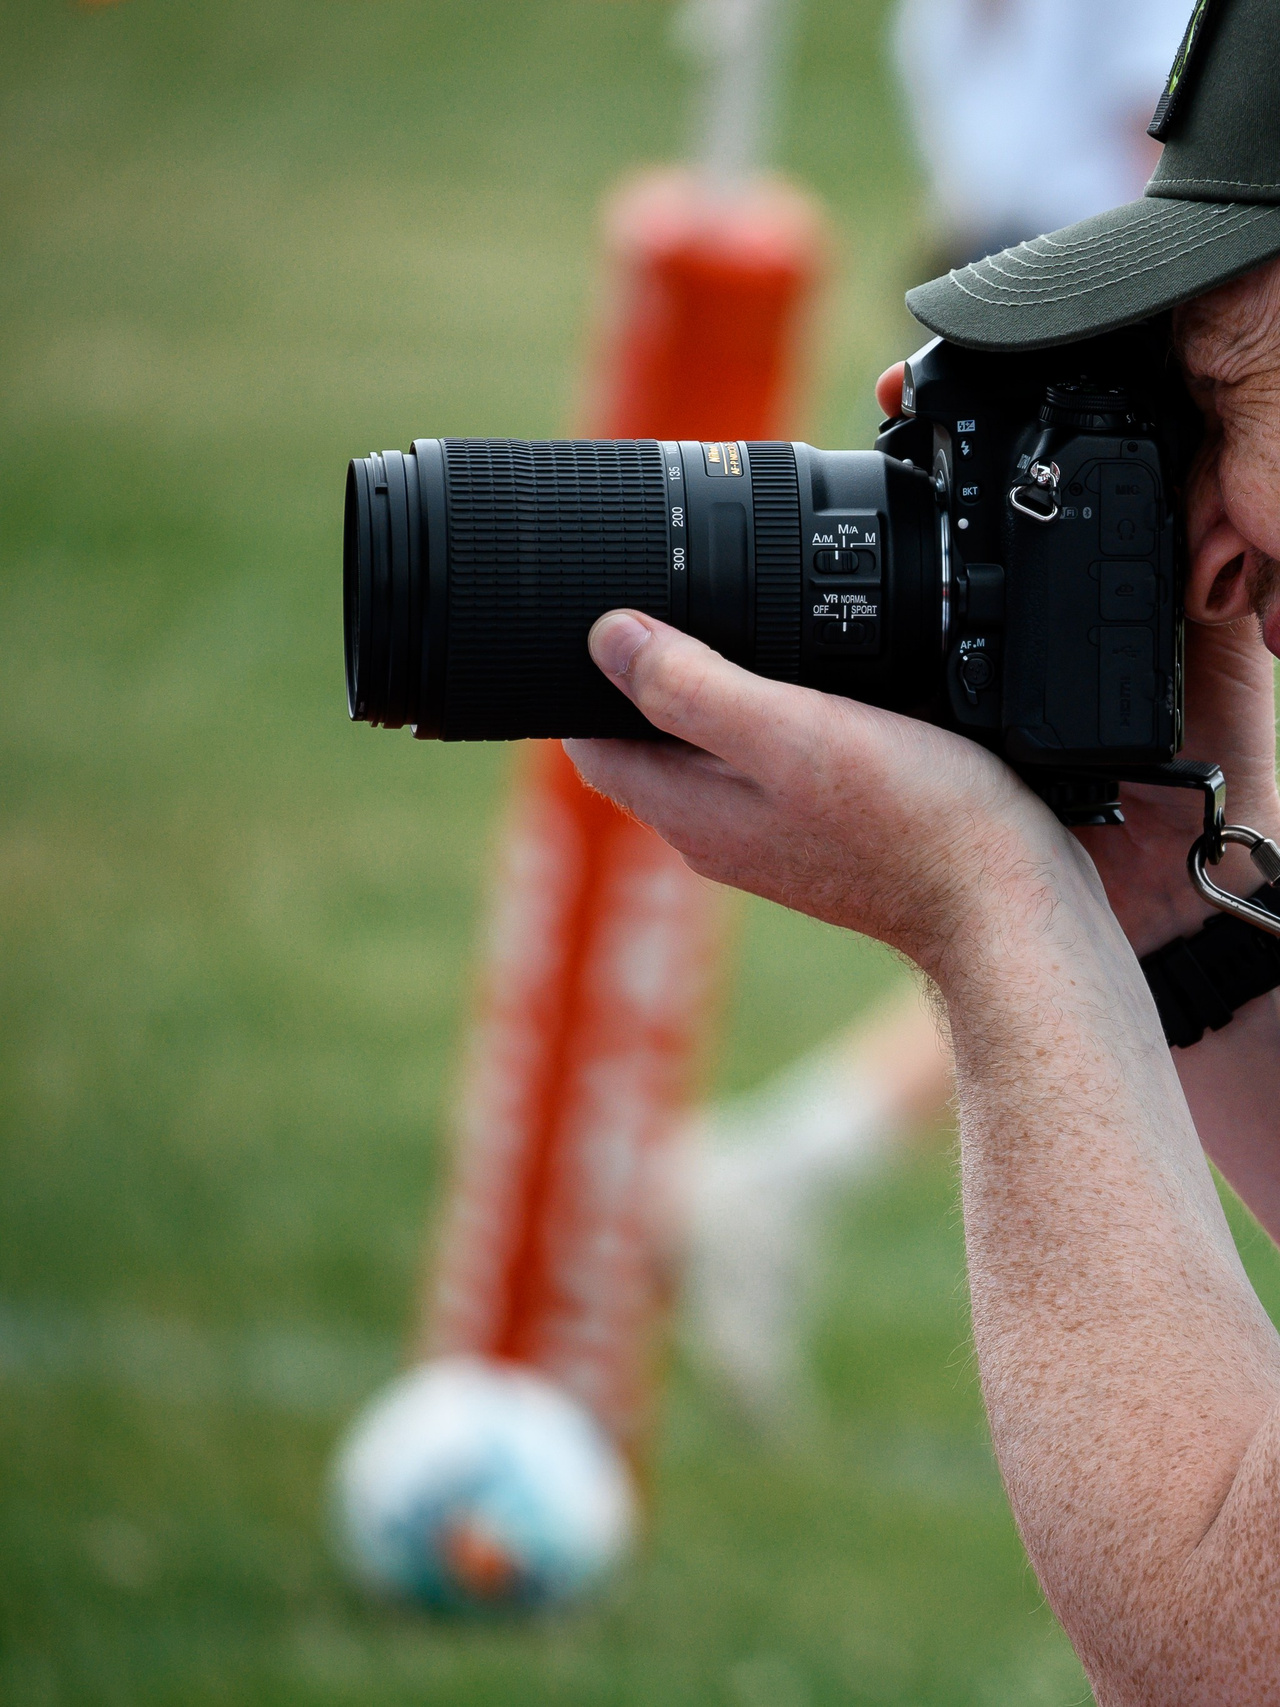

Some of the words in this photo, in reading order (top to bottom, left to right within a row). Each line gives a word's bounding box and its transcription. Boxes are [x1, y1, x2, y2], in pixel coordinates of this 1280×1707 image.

[668, 466, 680, 481] 135
[962, 486, 978, 497] BKT
[671, 506, 684, 527] 200
[812, 532, 834, 543] A/M
[838, 524, 859, 534] M/A
[865, 532, 876, 543] M
[673, 547, 685, 571] 300
[823, 594, 838, 604] VR
[841, 595, 868, 604] NORMAL
[813, 605, 829, 614] OFF
[851, 605, 877, 614] SPORT
[960, 640, 972, 649] AF
[976, 638, 985, 647] M
